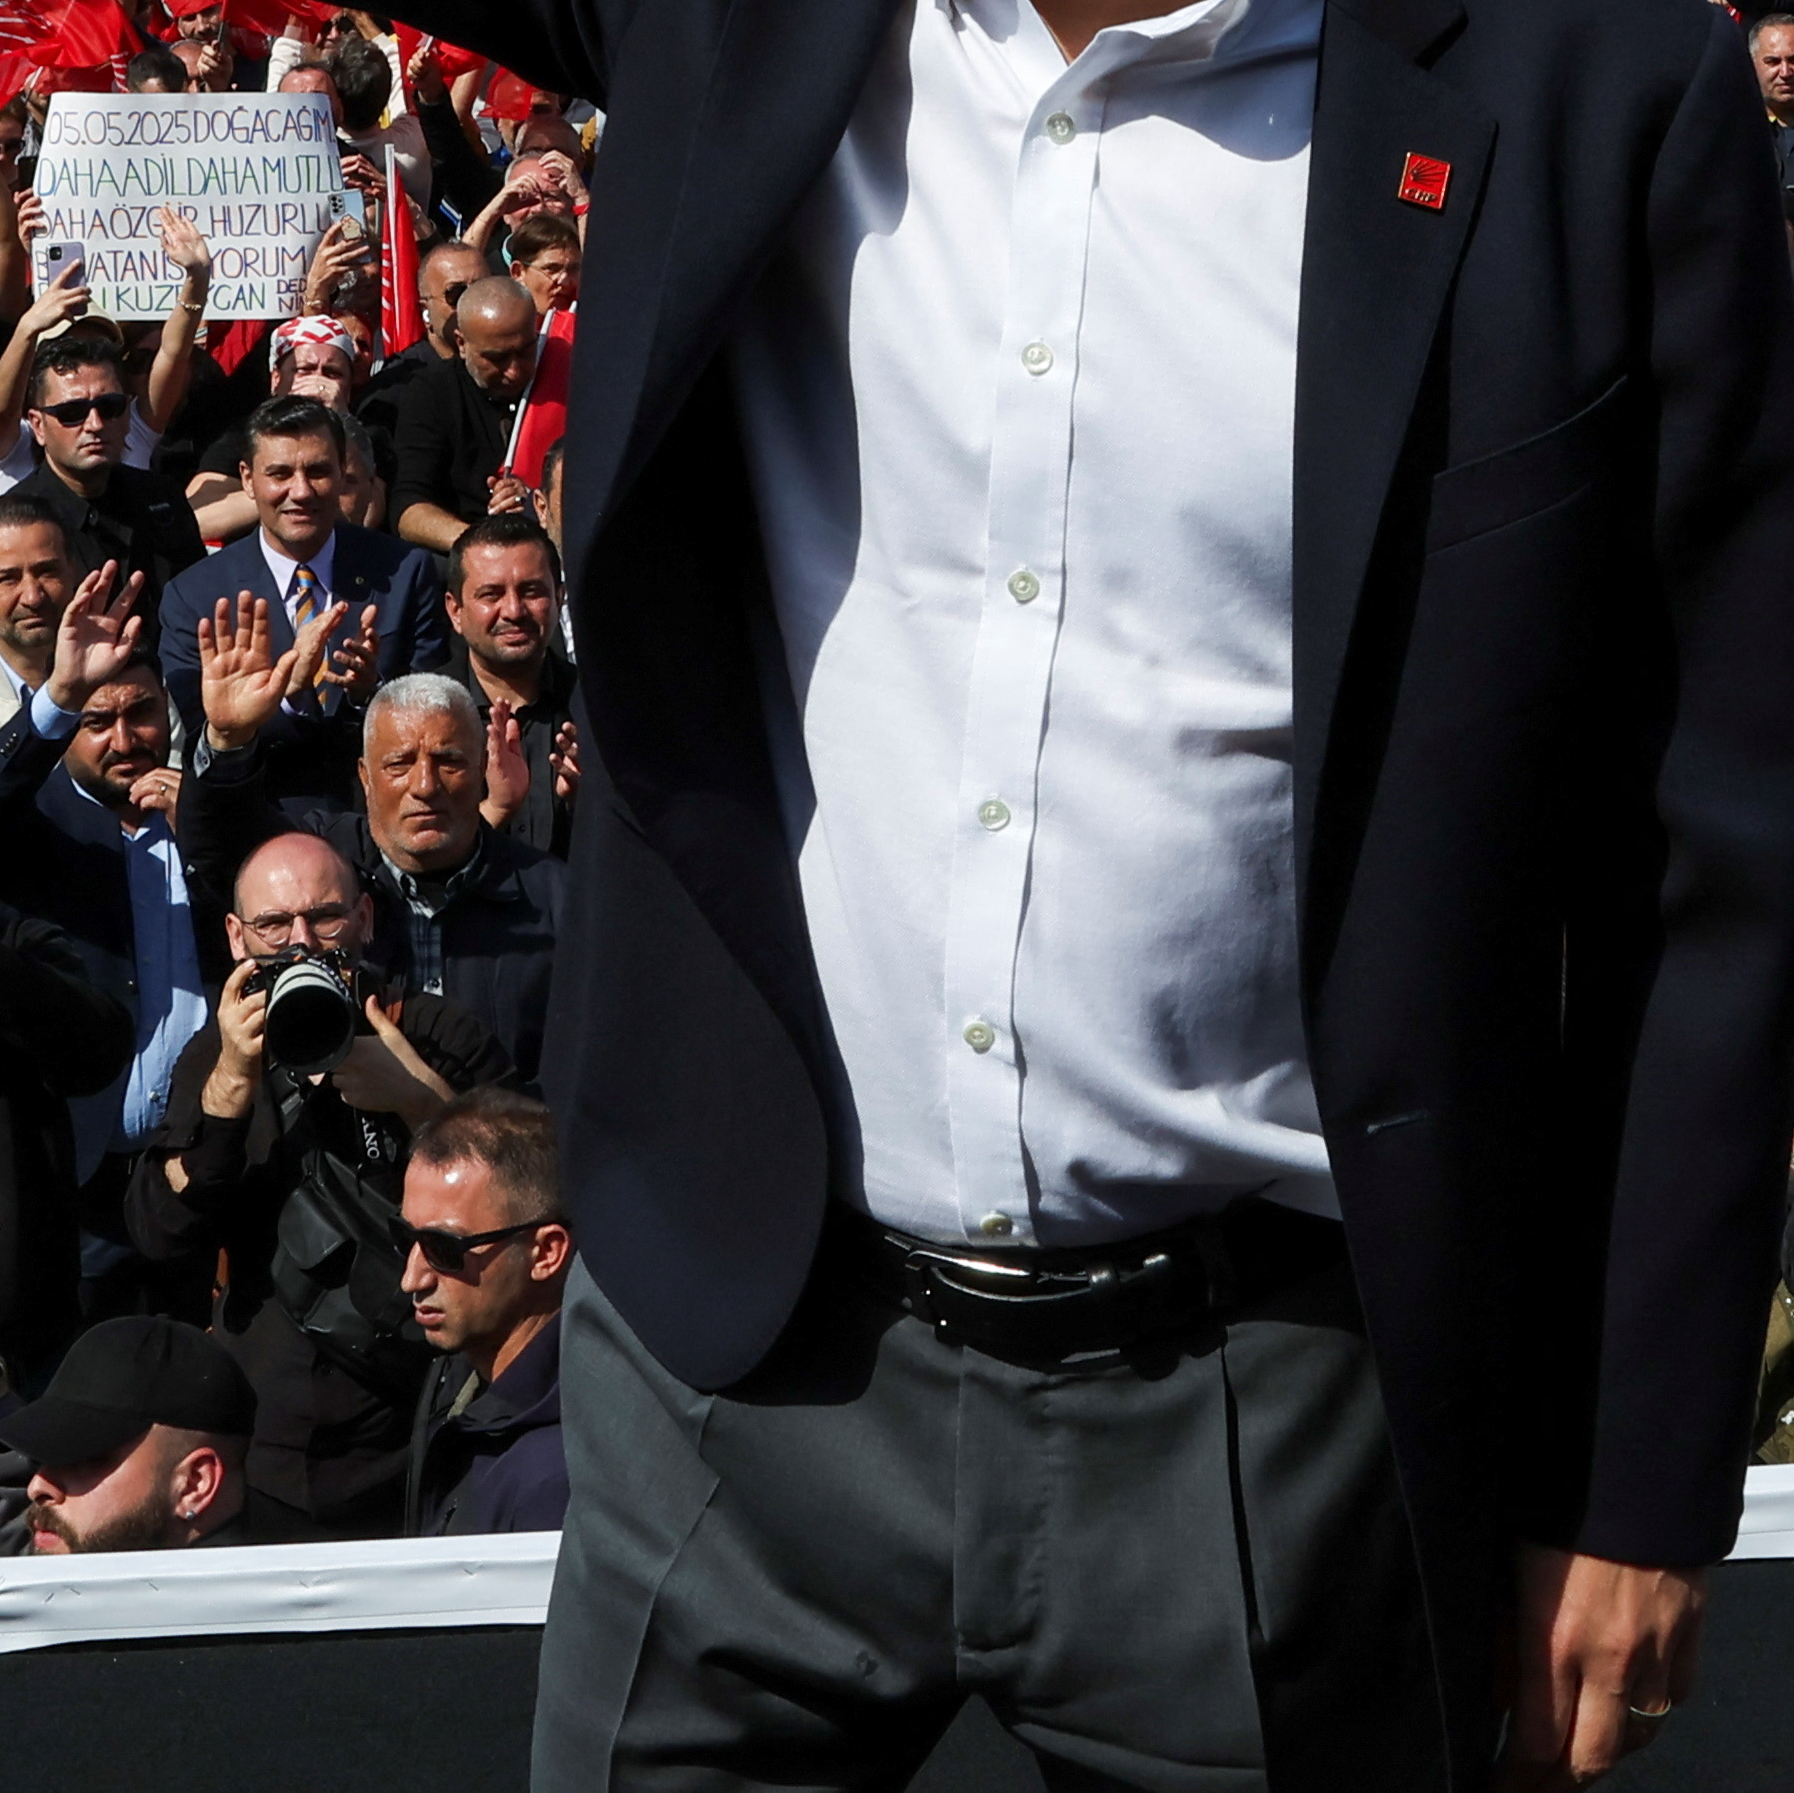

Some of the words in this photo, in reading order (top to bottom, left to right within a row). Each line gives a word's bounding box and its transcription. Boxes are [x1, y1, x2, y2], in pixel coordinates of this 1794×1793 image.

[36, 156, 125, 198] DAHA
[121, 153, 188, 198] ADİL
[187, 156, 260, 197] DAHA
[261, 153, 346, 196] MUTLU
[210, 202, 332, 238] HUZURLU
